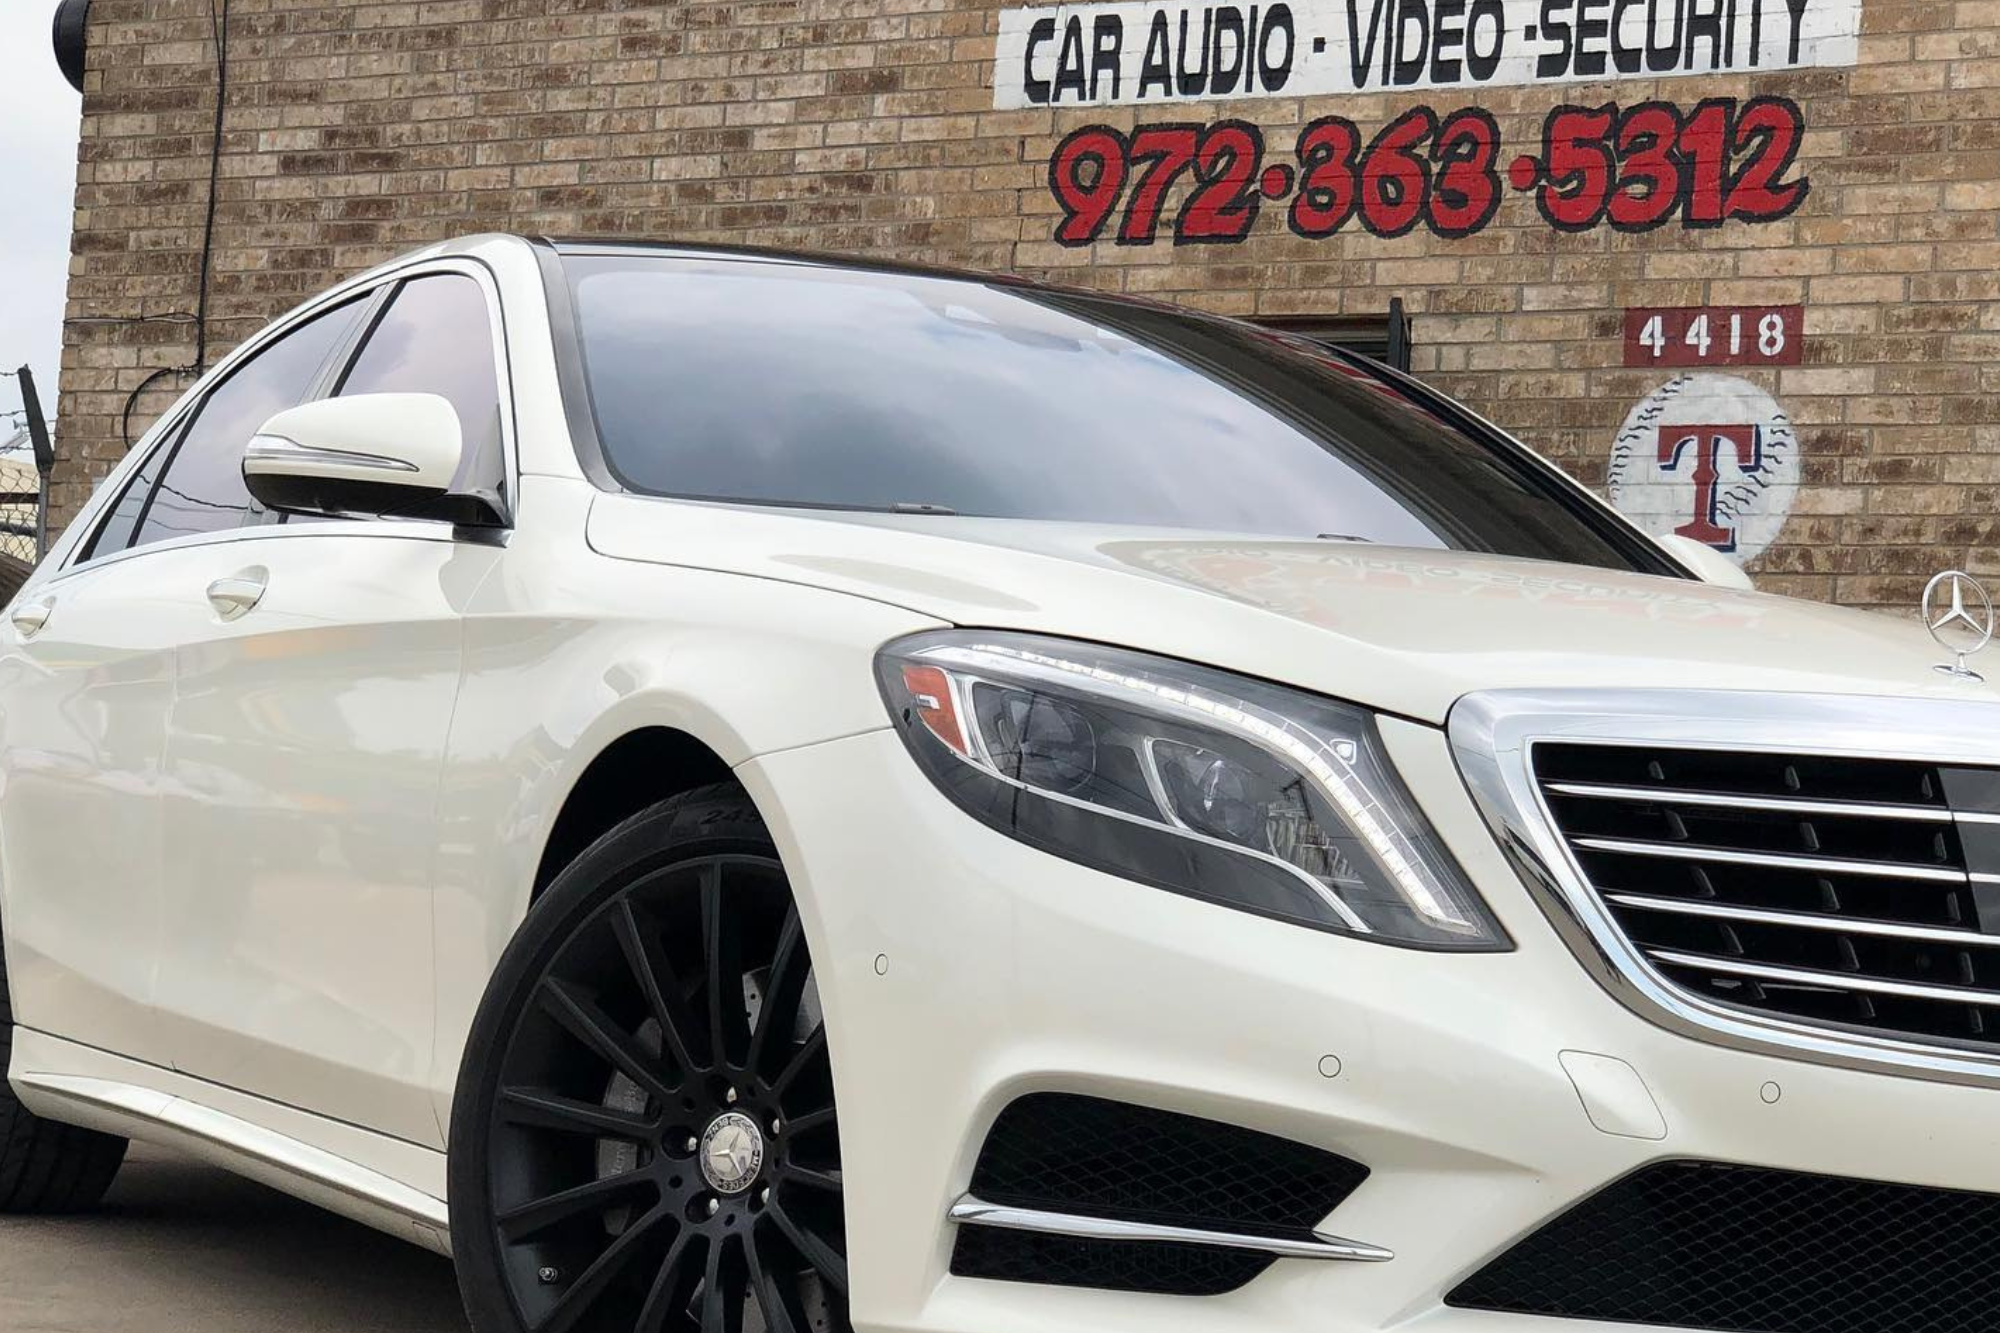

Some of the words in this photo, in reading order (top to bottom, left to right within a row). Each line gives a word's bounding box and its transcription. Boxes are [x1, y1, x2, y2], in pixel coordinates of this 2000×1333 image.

[1024, 14, 1124, 103] CAR
[1137, 3, 1296, 98] AUDIO
[1346, 0, 1505, 89] VIDEO
[1639, 313, 1786, 358] 4418
[1656, 423, 1763, 553] T
